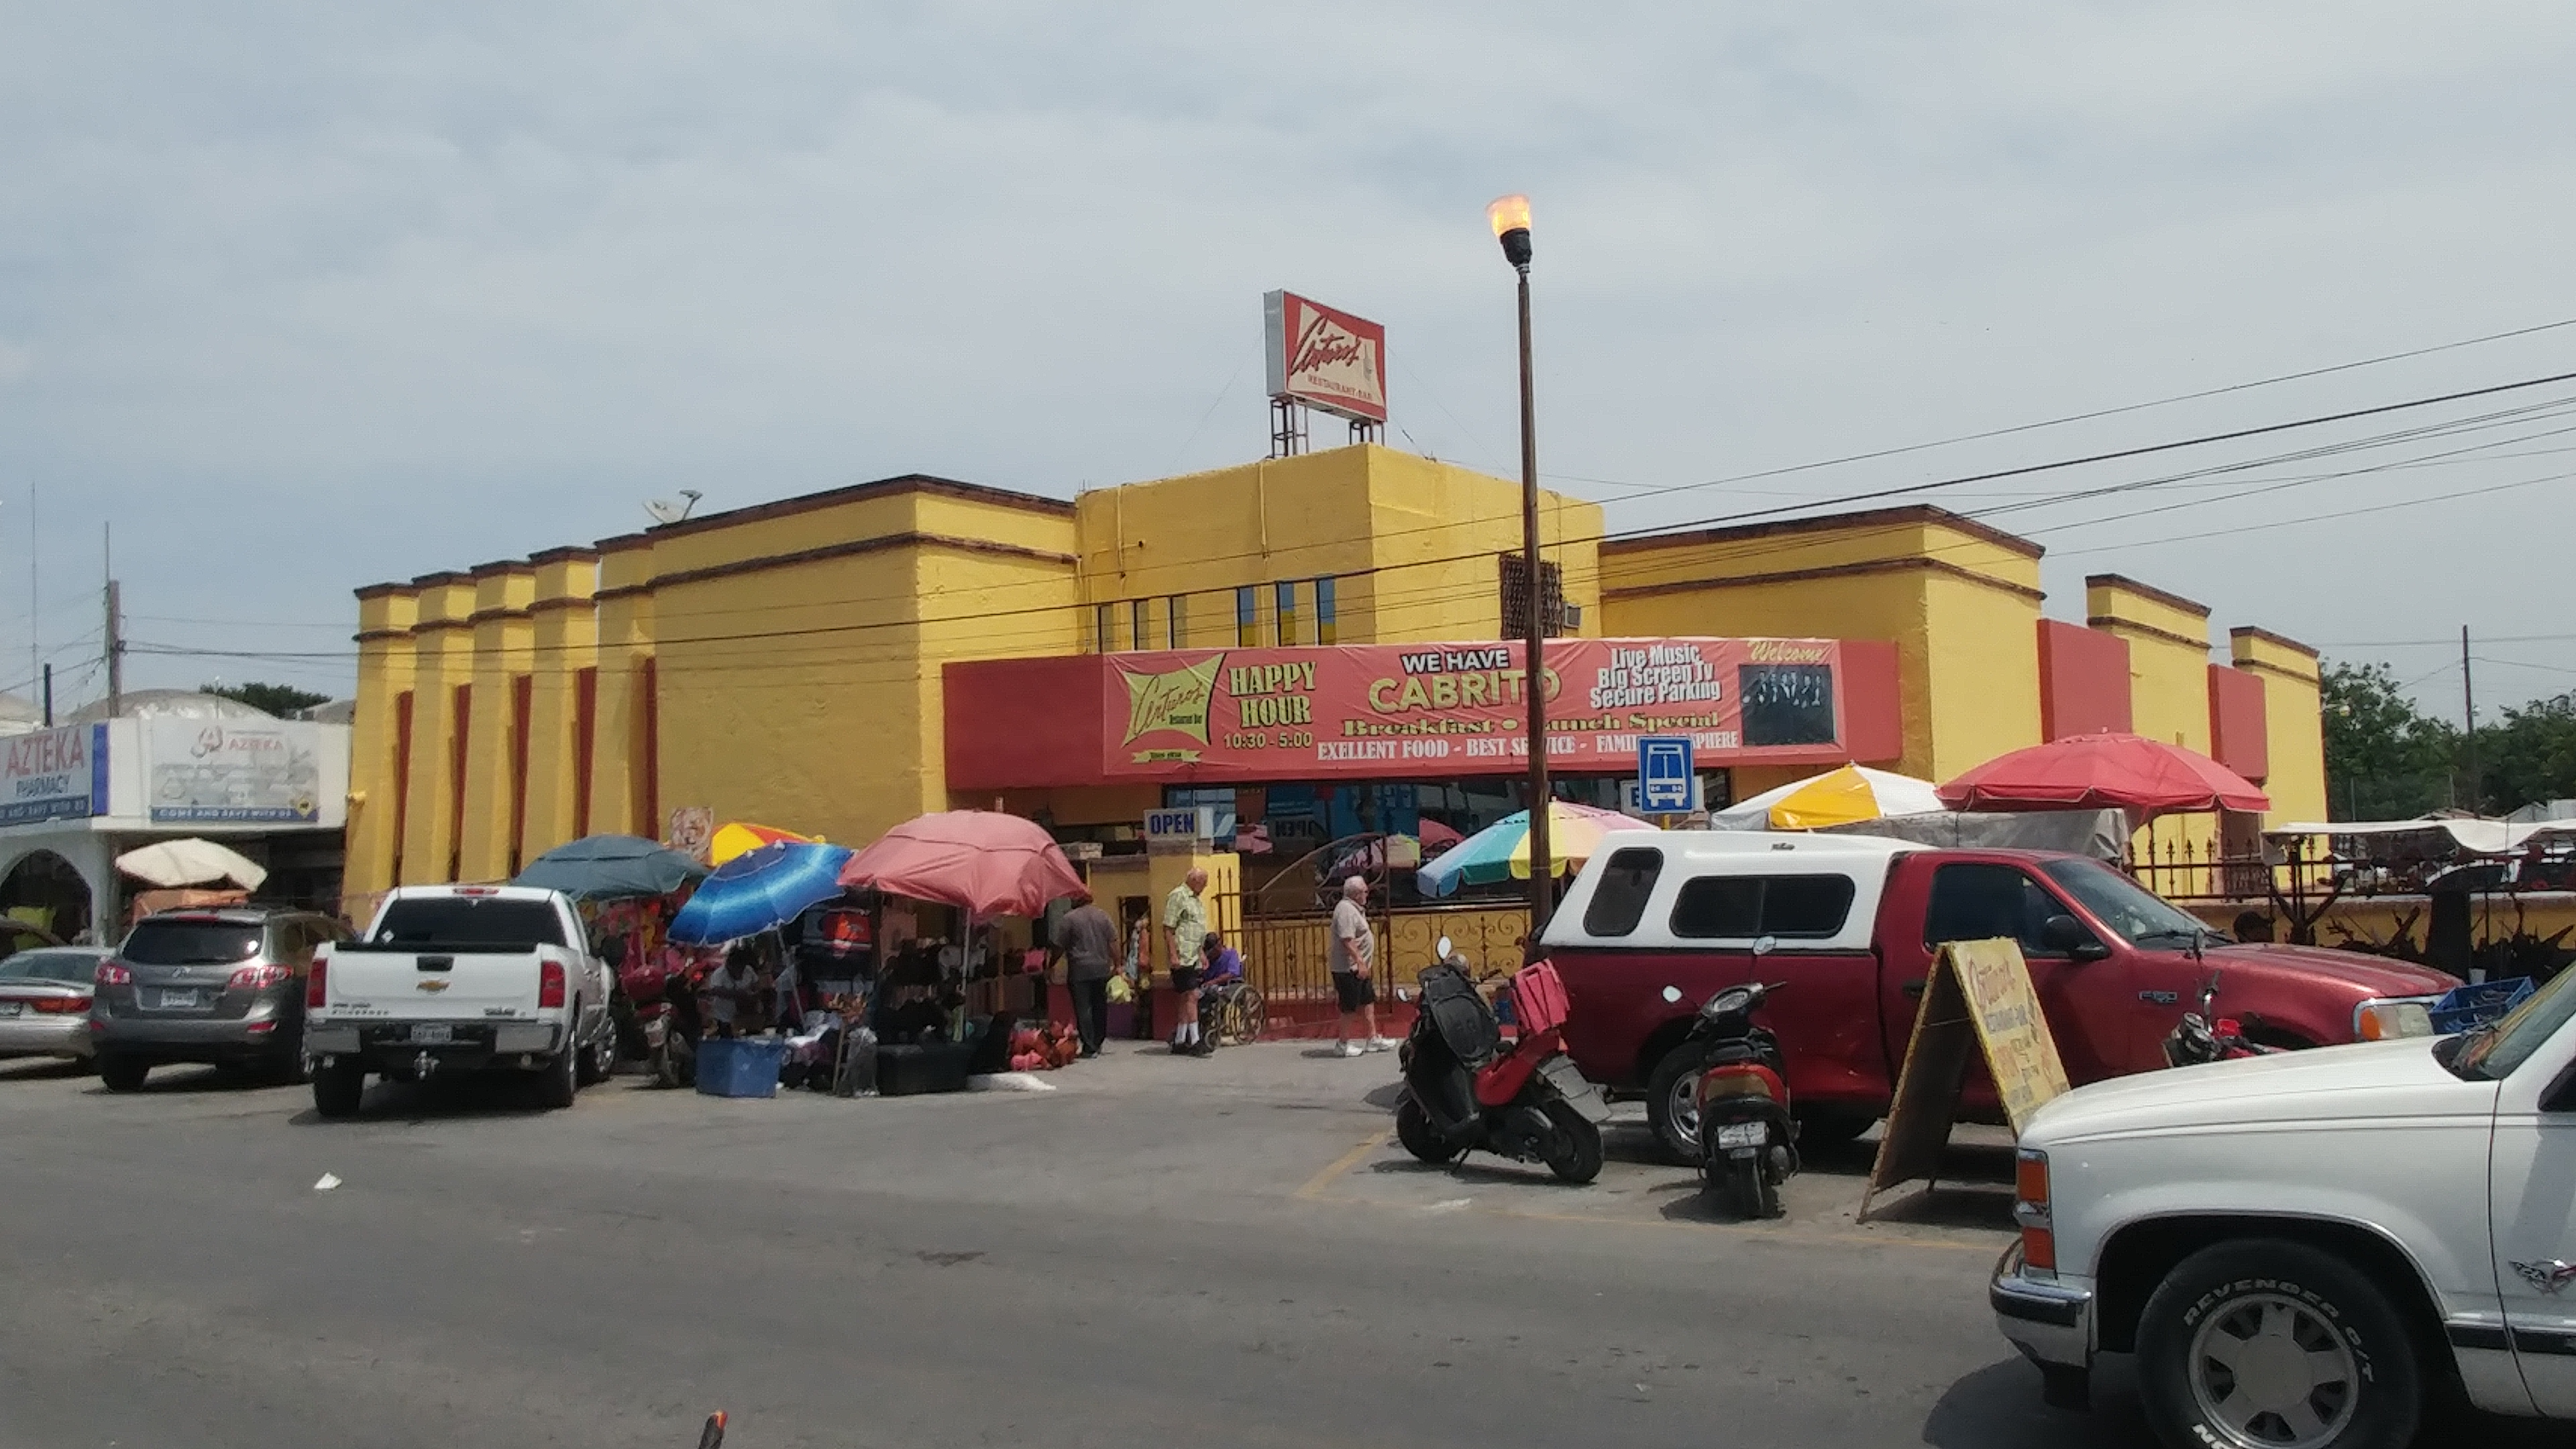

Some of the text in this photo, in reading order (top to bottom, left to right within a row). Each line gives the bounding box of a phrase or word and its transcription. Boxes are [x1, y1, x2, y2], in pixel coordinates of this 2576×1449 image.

[1401, 649, 1510, 674] WE HAVE
[1611, 644, 1700, 670] Live Music
[1229, 661, 1316, 696] HAPPY
[1598, 667, 1628, 689] Big
[1631, 664, 1693, 687] Screen
[1368, 667, 1562, 714] CABRITO
[1591, 680, 1721, 709] Secure Parking
[1240, 695, 1313, 729] HOUR
[1342, 712, 1721, 737] Breakfast unch Special
[5, 728, 85, 778] AZTEKA
[229, 738, 283, 750] AZTEKA
[1224, 733, 1267, 749] 10:30
[1277, 732, 1313, 749] 5:00
[1402, 739, 1449, 758] FOOD
[1466, 738, 1507, 756] BEST
[1511, 736, 1576, 756] SEICE
[1595, 735, 1640, 753] FAMIL
[1150, 812, 1194, 835] OPEN
